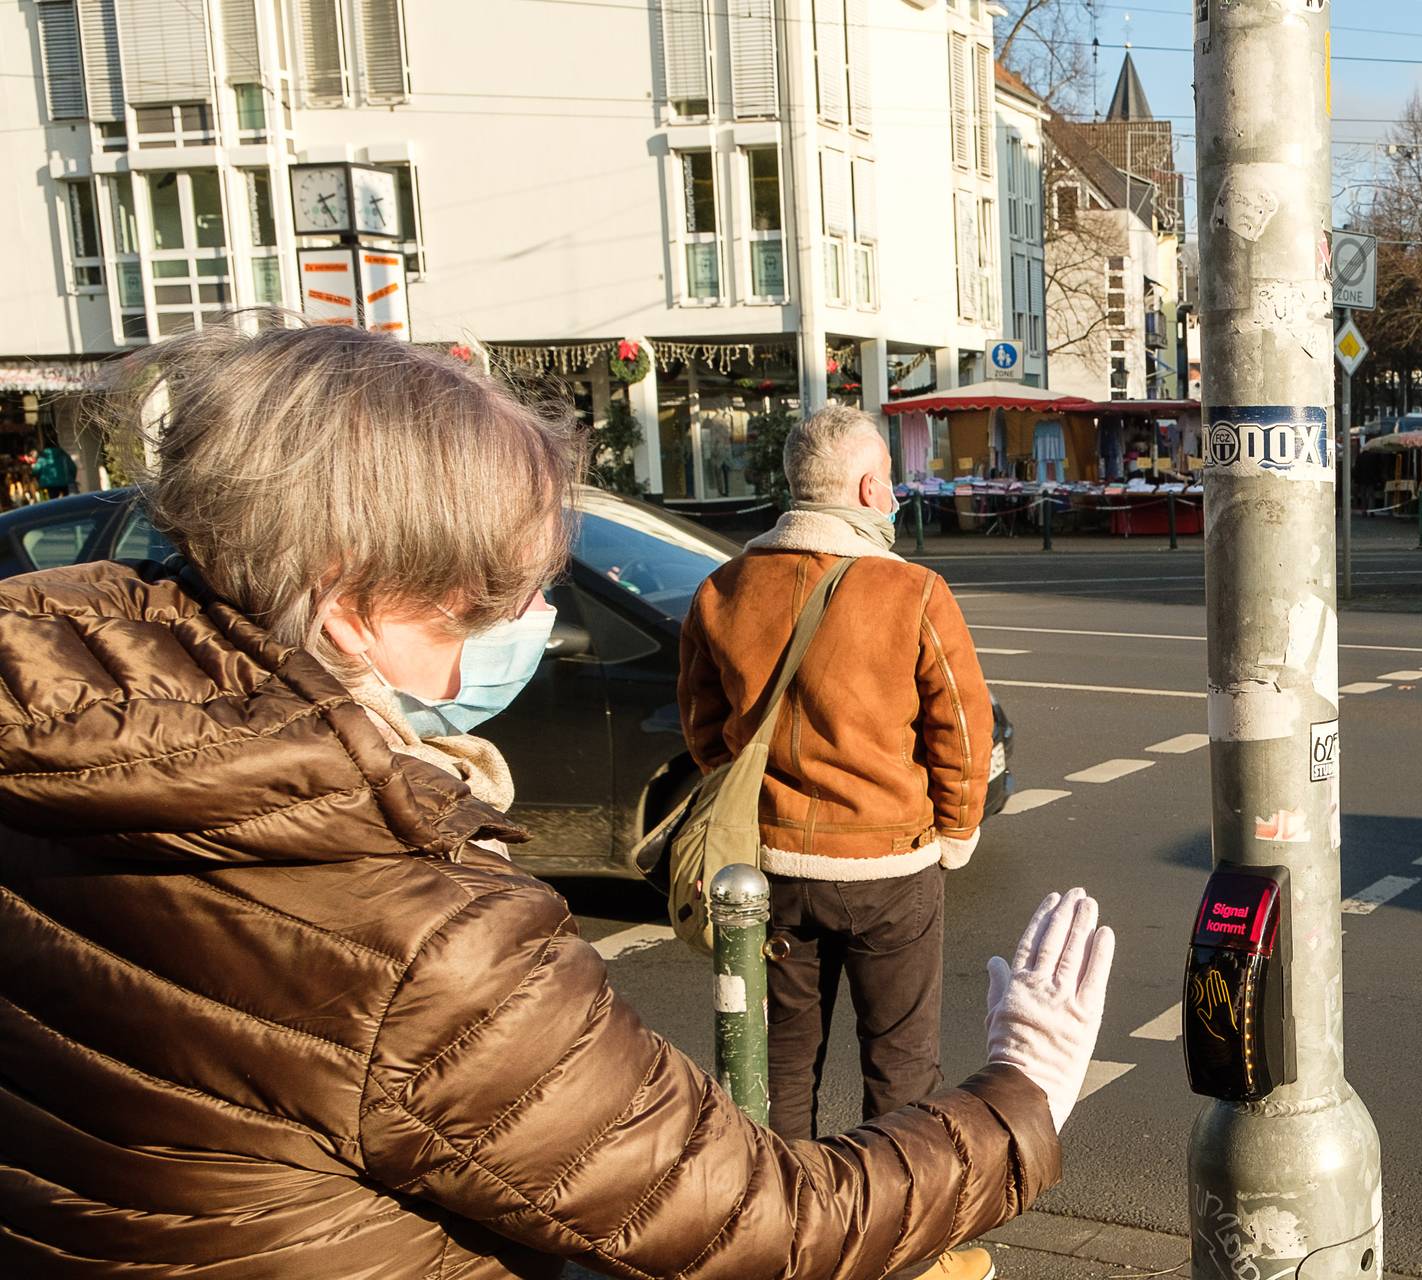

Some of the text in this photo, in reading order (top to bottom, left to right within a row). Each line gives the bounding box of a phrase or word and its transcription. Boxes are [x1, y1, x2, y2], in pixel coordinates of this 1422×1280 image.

[1337, 289, 1363, 303] ZONE
[994, 369, 1015, 378] ZONE
[1215, 433, 1231, 443] FCZ
[1212, 902, 1249, 918] Signal
[1206, 919, 1247, 935] kommt
